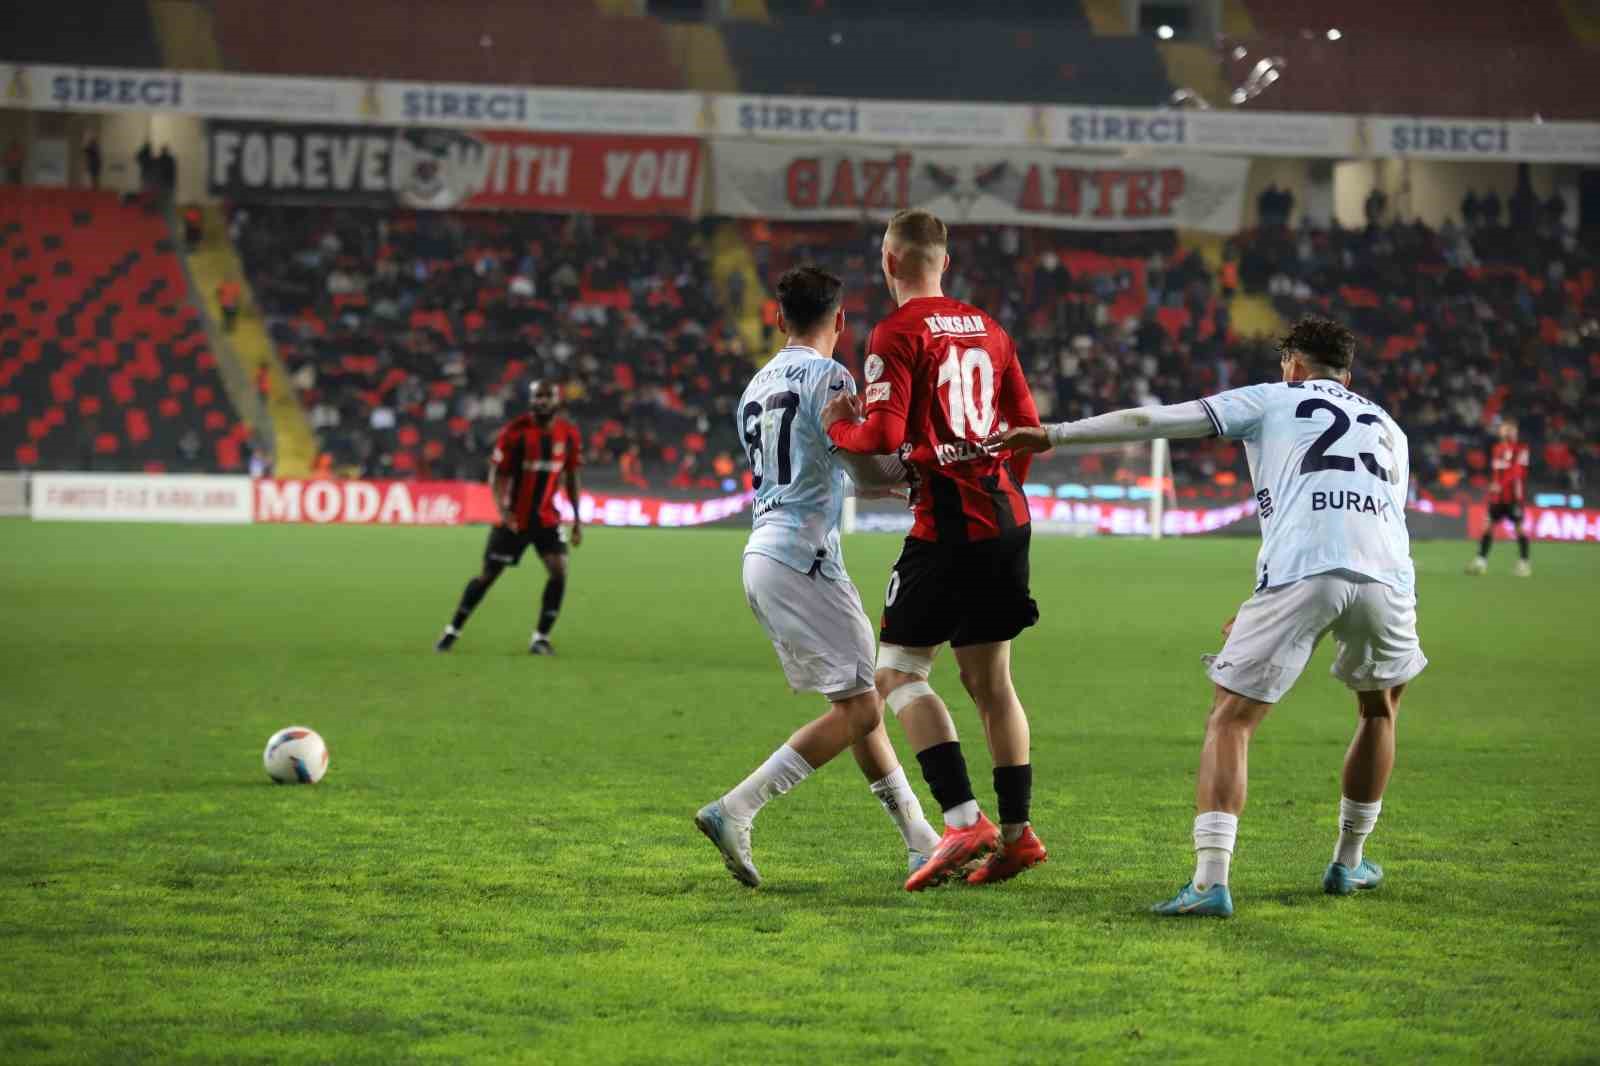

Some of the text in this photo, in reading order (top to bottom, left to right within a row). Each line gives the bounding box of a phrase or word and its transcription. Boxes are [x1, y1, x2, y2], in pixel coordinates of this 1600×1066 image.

[213, 129, 401, 191] FOREVE
[602, 149, 692, 199] YOU
[924, 313, 987, 334] KÖKSAN
[936, 344, 996, 440] 10
[742, 390, 801, 490] 87
[1295, 397, 1400, 486] 23
[258, 480, 415, 524] MODA
[1312, 490, 1391, 523] BURAK
